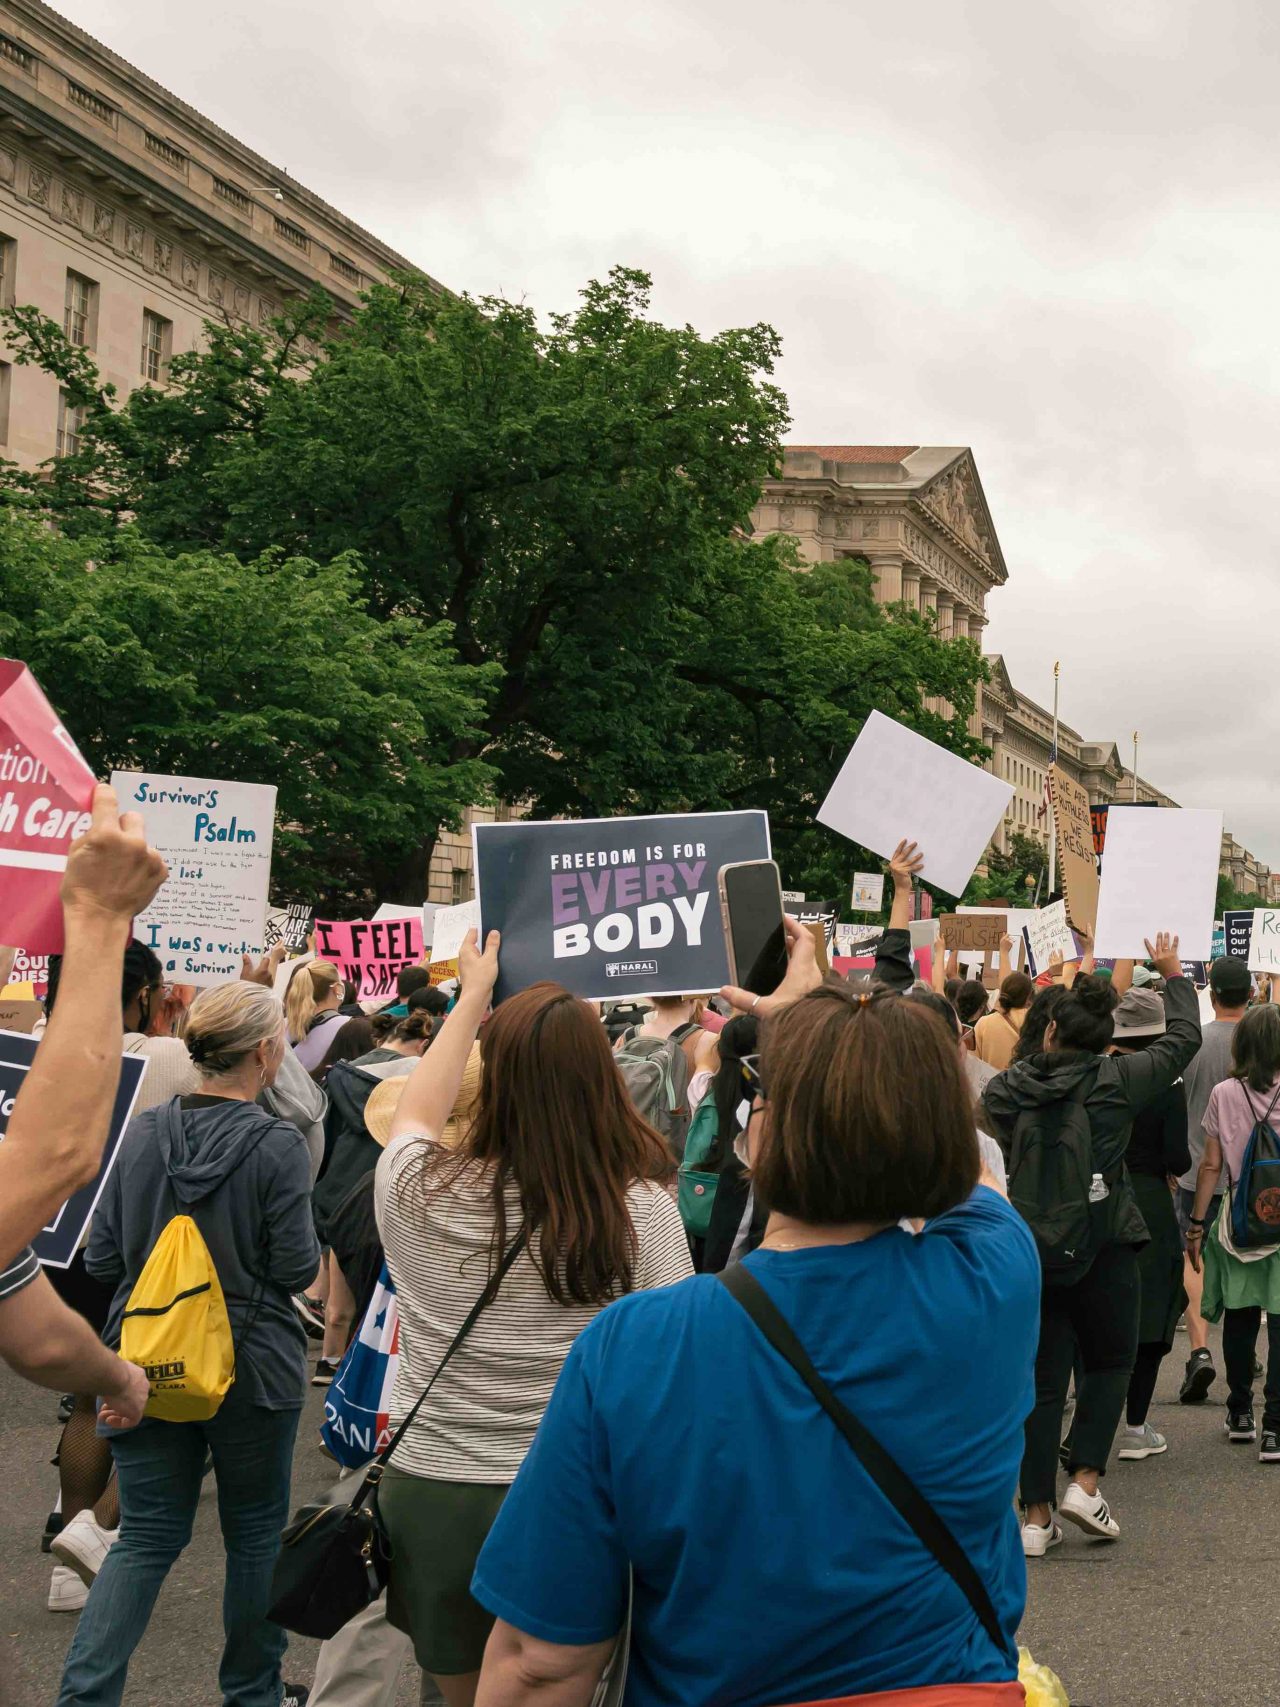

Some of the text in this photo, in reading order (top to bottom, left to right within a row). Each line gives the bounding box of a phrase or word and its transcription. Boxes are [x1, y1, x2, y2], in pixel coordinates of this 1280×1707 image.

[1058, 777, 1071, 796] WE
[23, 797, 94, 839] Care
[194, 812, 256, 843] Psalm
[550, 842, 707, 871] FREEDOM IS FOR
[180, 867, 203, 879] lost
[551, 860, 707, 926] EVERY
[287, 903, 312, 920] HOW
[286, 917, 310, 935] ARE
[553, 891, 710, 959] BODY
[944, 917, 1000, 928] THIS IS
[147, 924, 162, 948] I
[206, 942, 213, 953] a
[218, 941, 261, 955] victim
[284, 932, 304, 948] HEY.
[317, 922, 419, 959] I FEEL
[166, 958, 236, 974] a Survivor
[621, 963, 654, 971] NARAL
[8, 970, 49, 985] DIES
[324, 1401, 394, 1454] PANA
